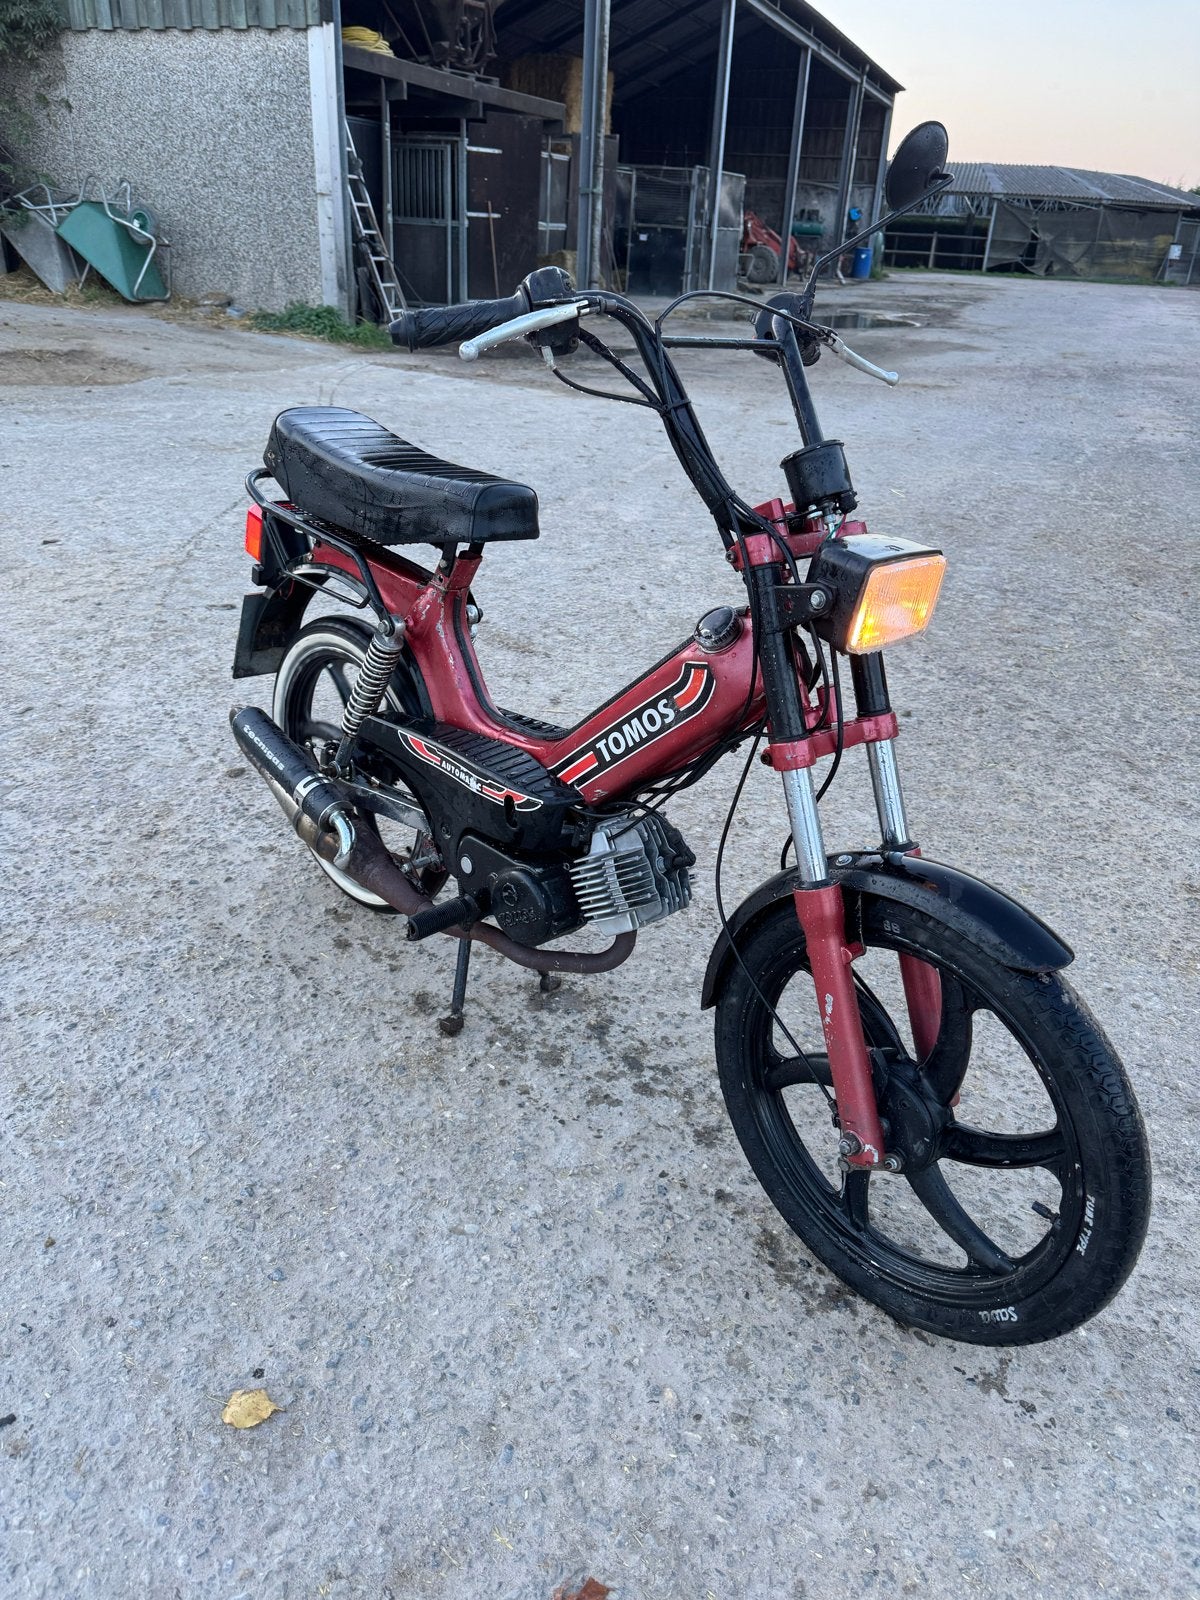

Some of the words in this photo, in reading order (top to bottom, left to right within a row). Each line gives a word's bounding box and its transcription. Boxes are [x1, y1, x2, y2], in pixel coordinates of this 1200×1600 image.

[595, 698, 676, 762] TOMOS
[243, 724, 285, 771] tecnigas
[441, 760, 482, 791] AUTOMAC
[1085, 1194, 1096, 1226] TUBE
[1076, 1229, 1093, 1256] TYPE
